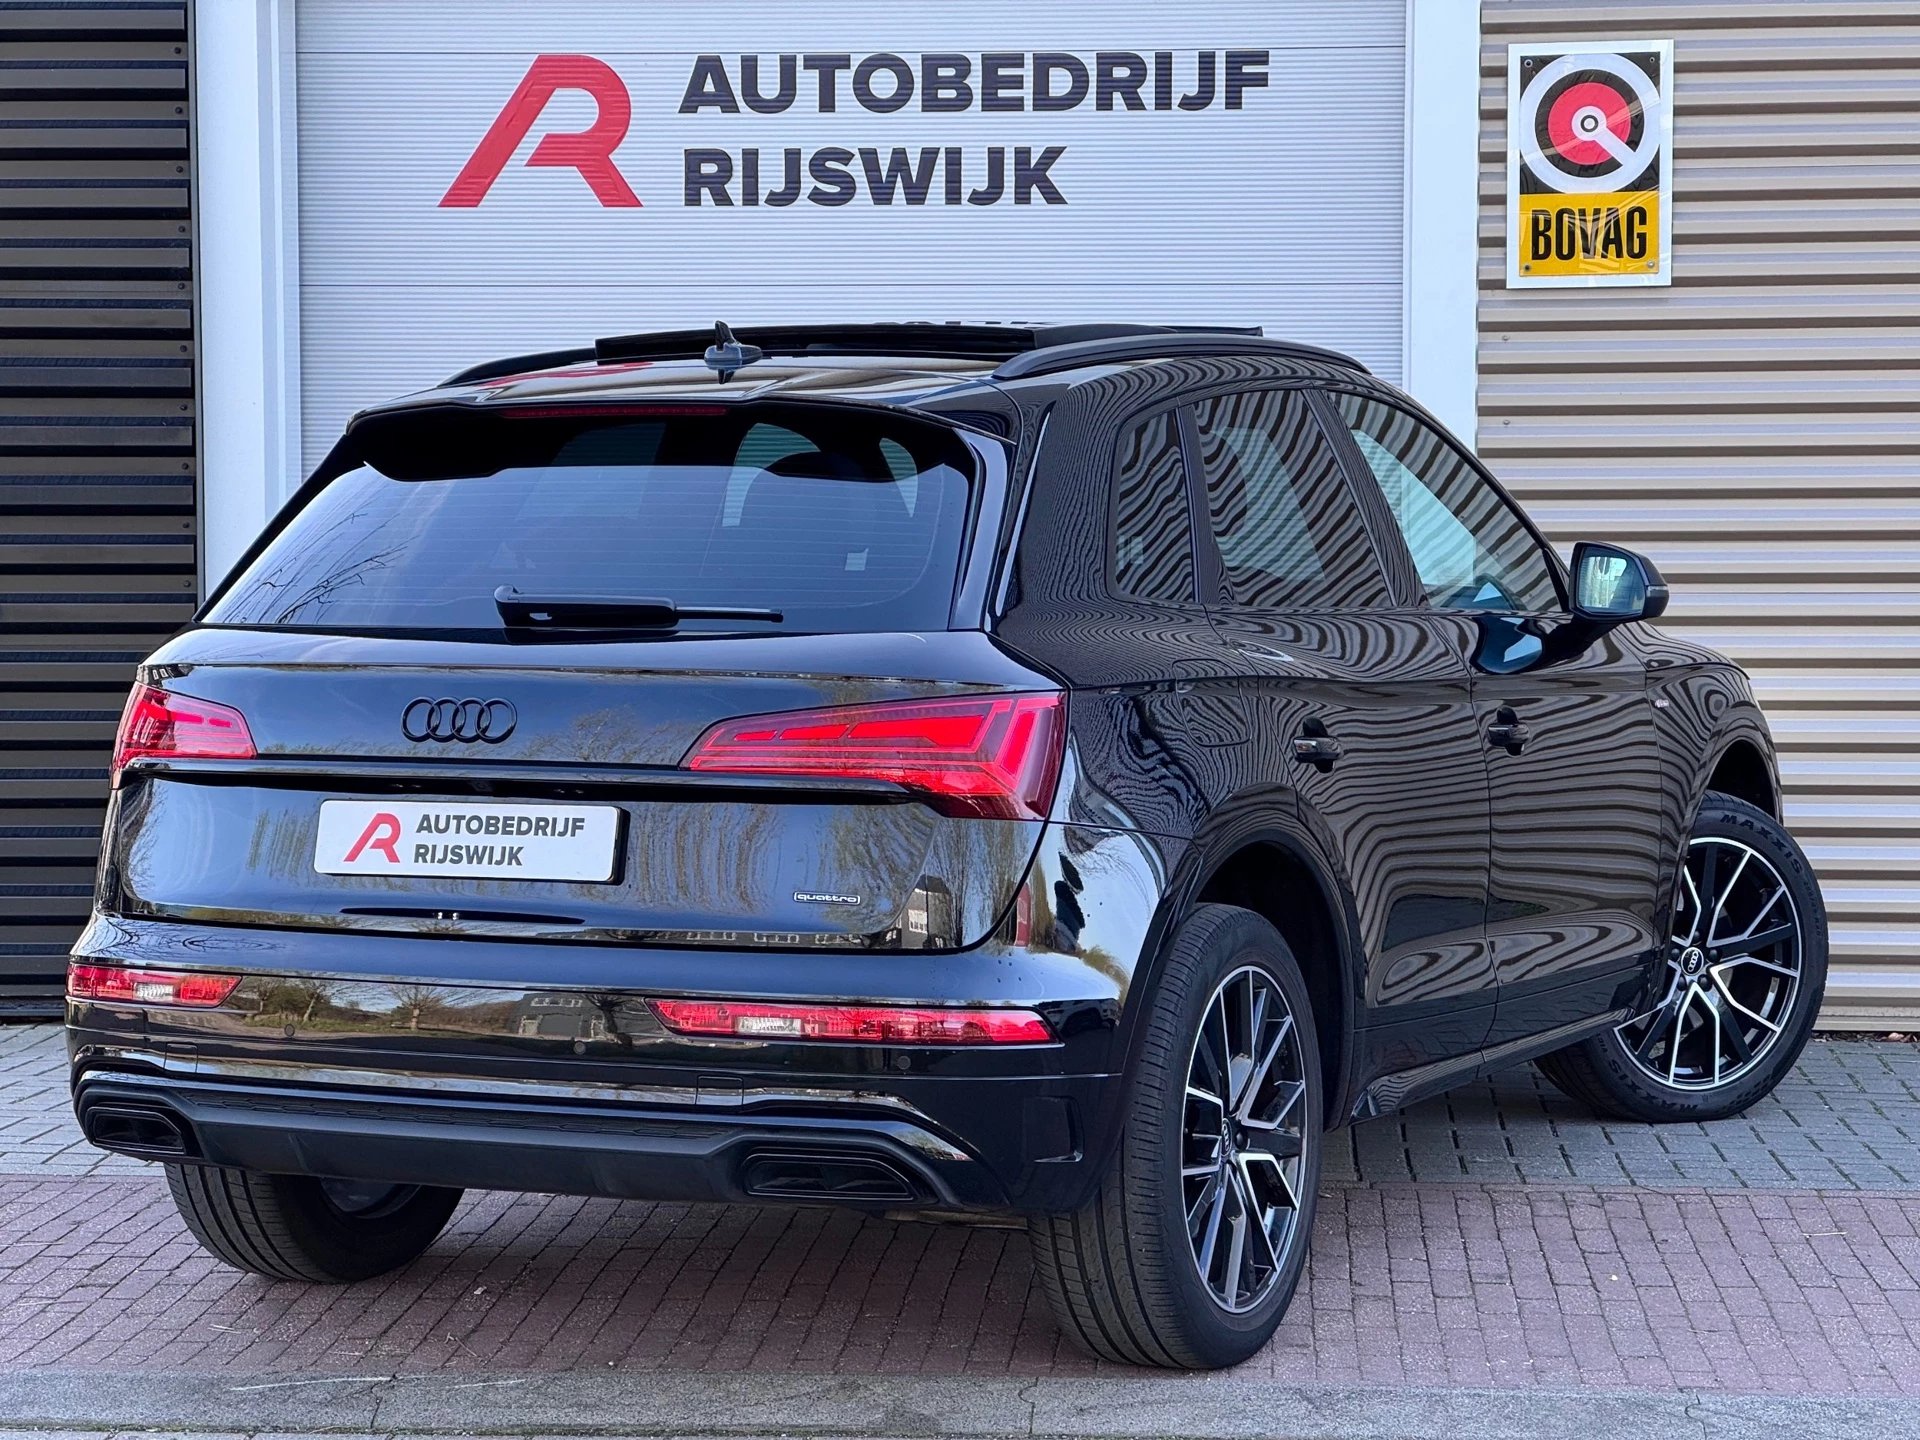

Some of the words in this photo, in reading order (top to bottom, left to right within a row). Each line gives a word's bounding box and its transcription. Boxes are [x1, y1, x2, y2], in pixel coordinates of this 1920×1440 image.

[678, 50, 1270, 114] AUTOBEDRIJF
[683, 146, 1068, 207] RIJSWIJK
[1531, 206, 1648, 261] BOVAG
[415, 813, 586, 838] AUTOBEDRIJF
[1720, 814, 1804, 874] MAXXIS
[413, 843, 525, 867] RIJSWIJK
[797, 893, 857, 903] quattro
[1608, 1059, 1698, 1113] MAXXIS
